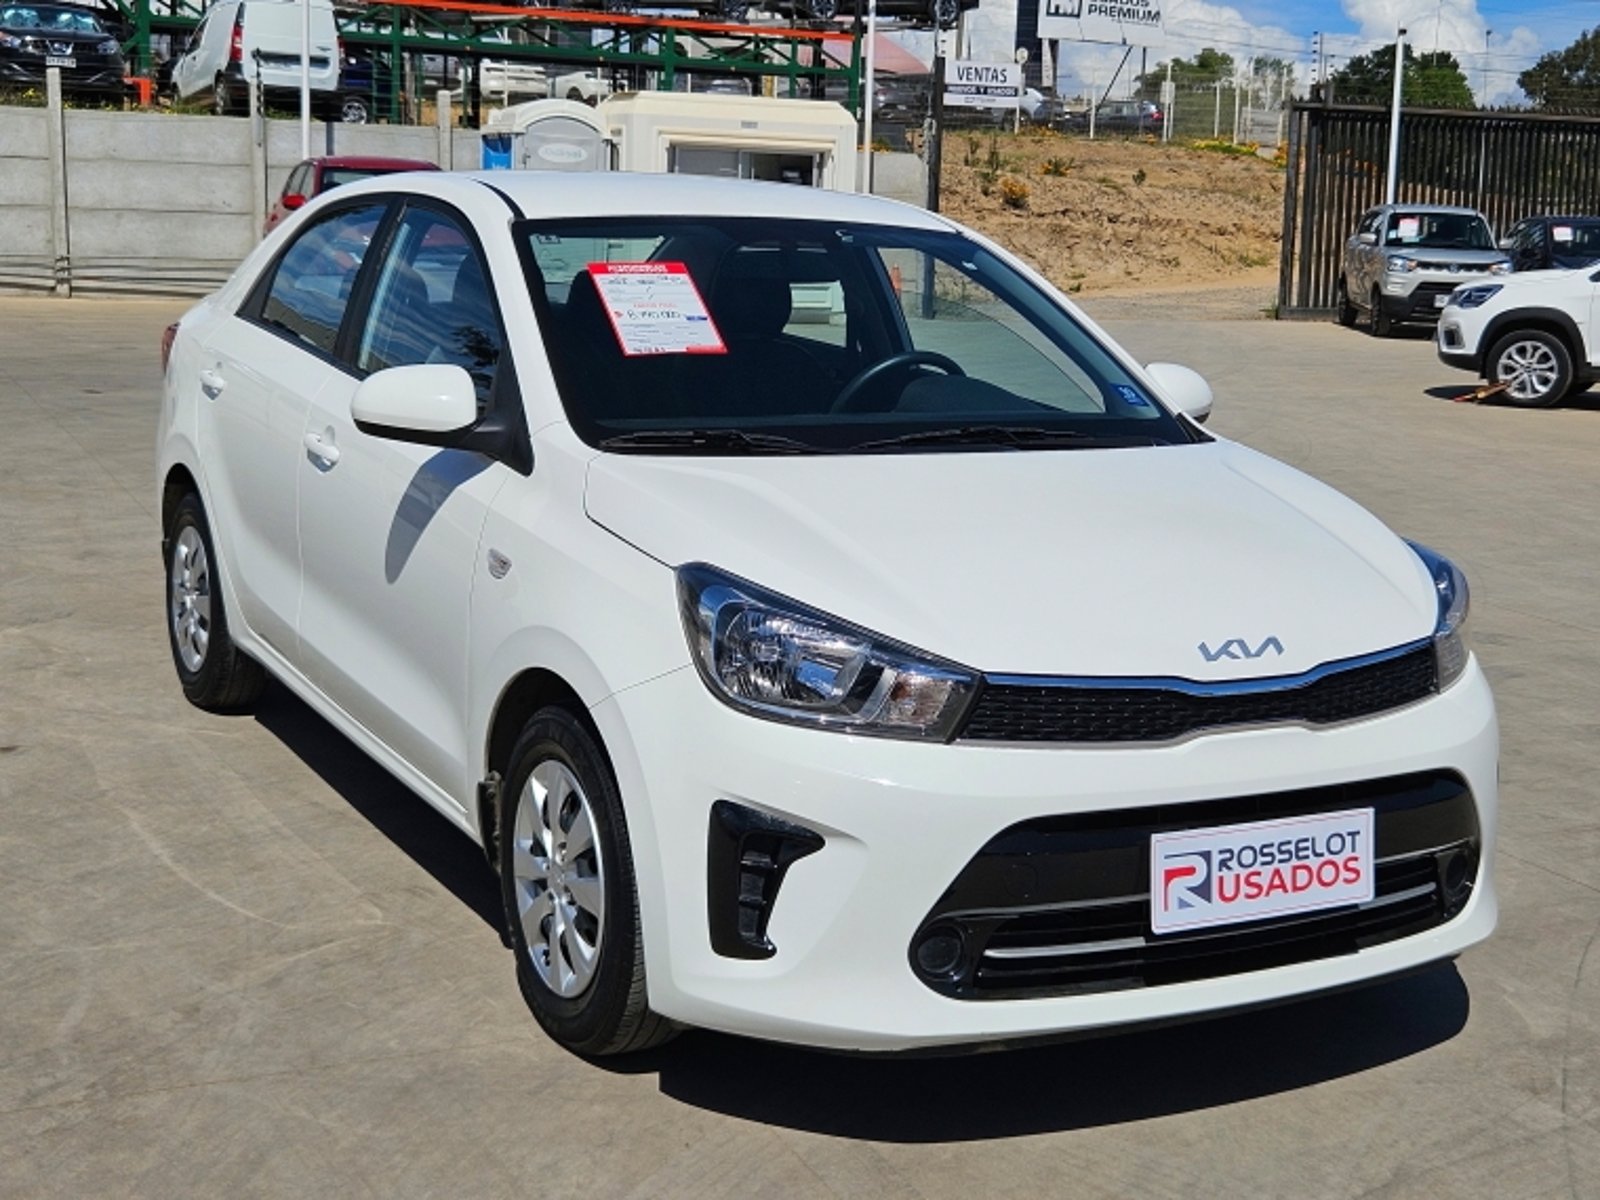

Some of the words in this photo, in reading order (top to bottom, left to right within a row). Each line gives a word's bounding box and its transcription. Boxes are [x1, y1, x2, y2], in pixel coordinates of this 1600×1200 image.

[1088, 4, 1161, 22] PREMIUM
[957, 65, 1007, 83] VENTAS
[1218, 831, 1361, 872] ROSSELOT
[1217, 856, 1361, 903] USADOS
